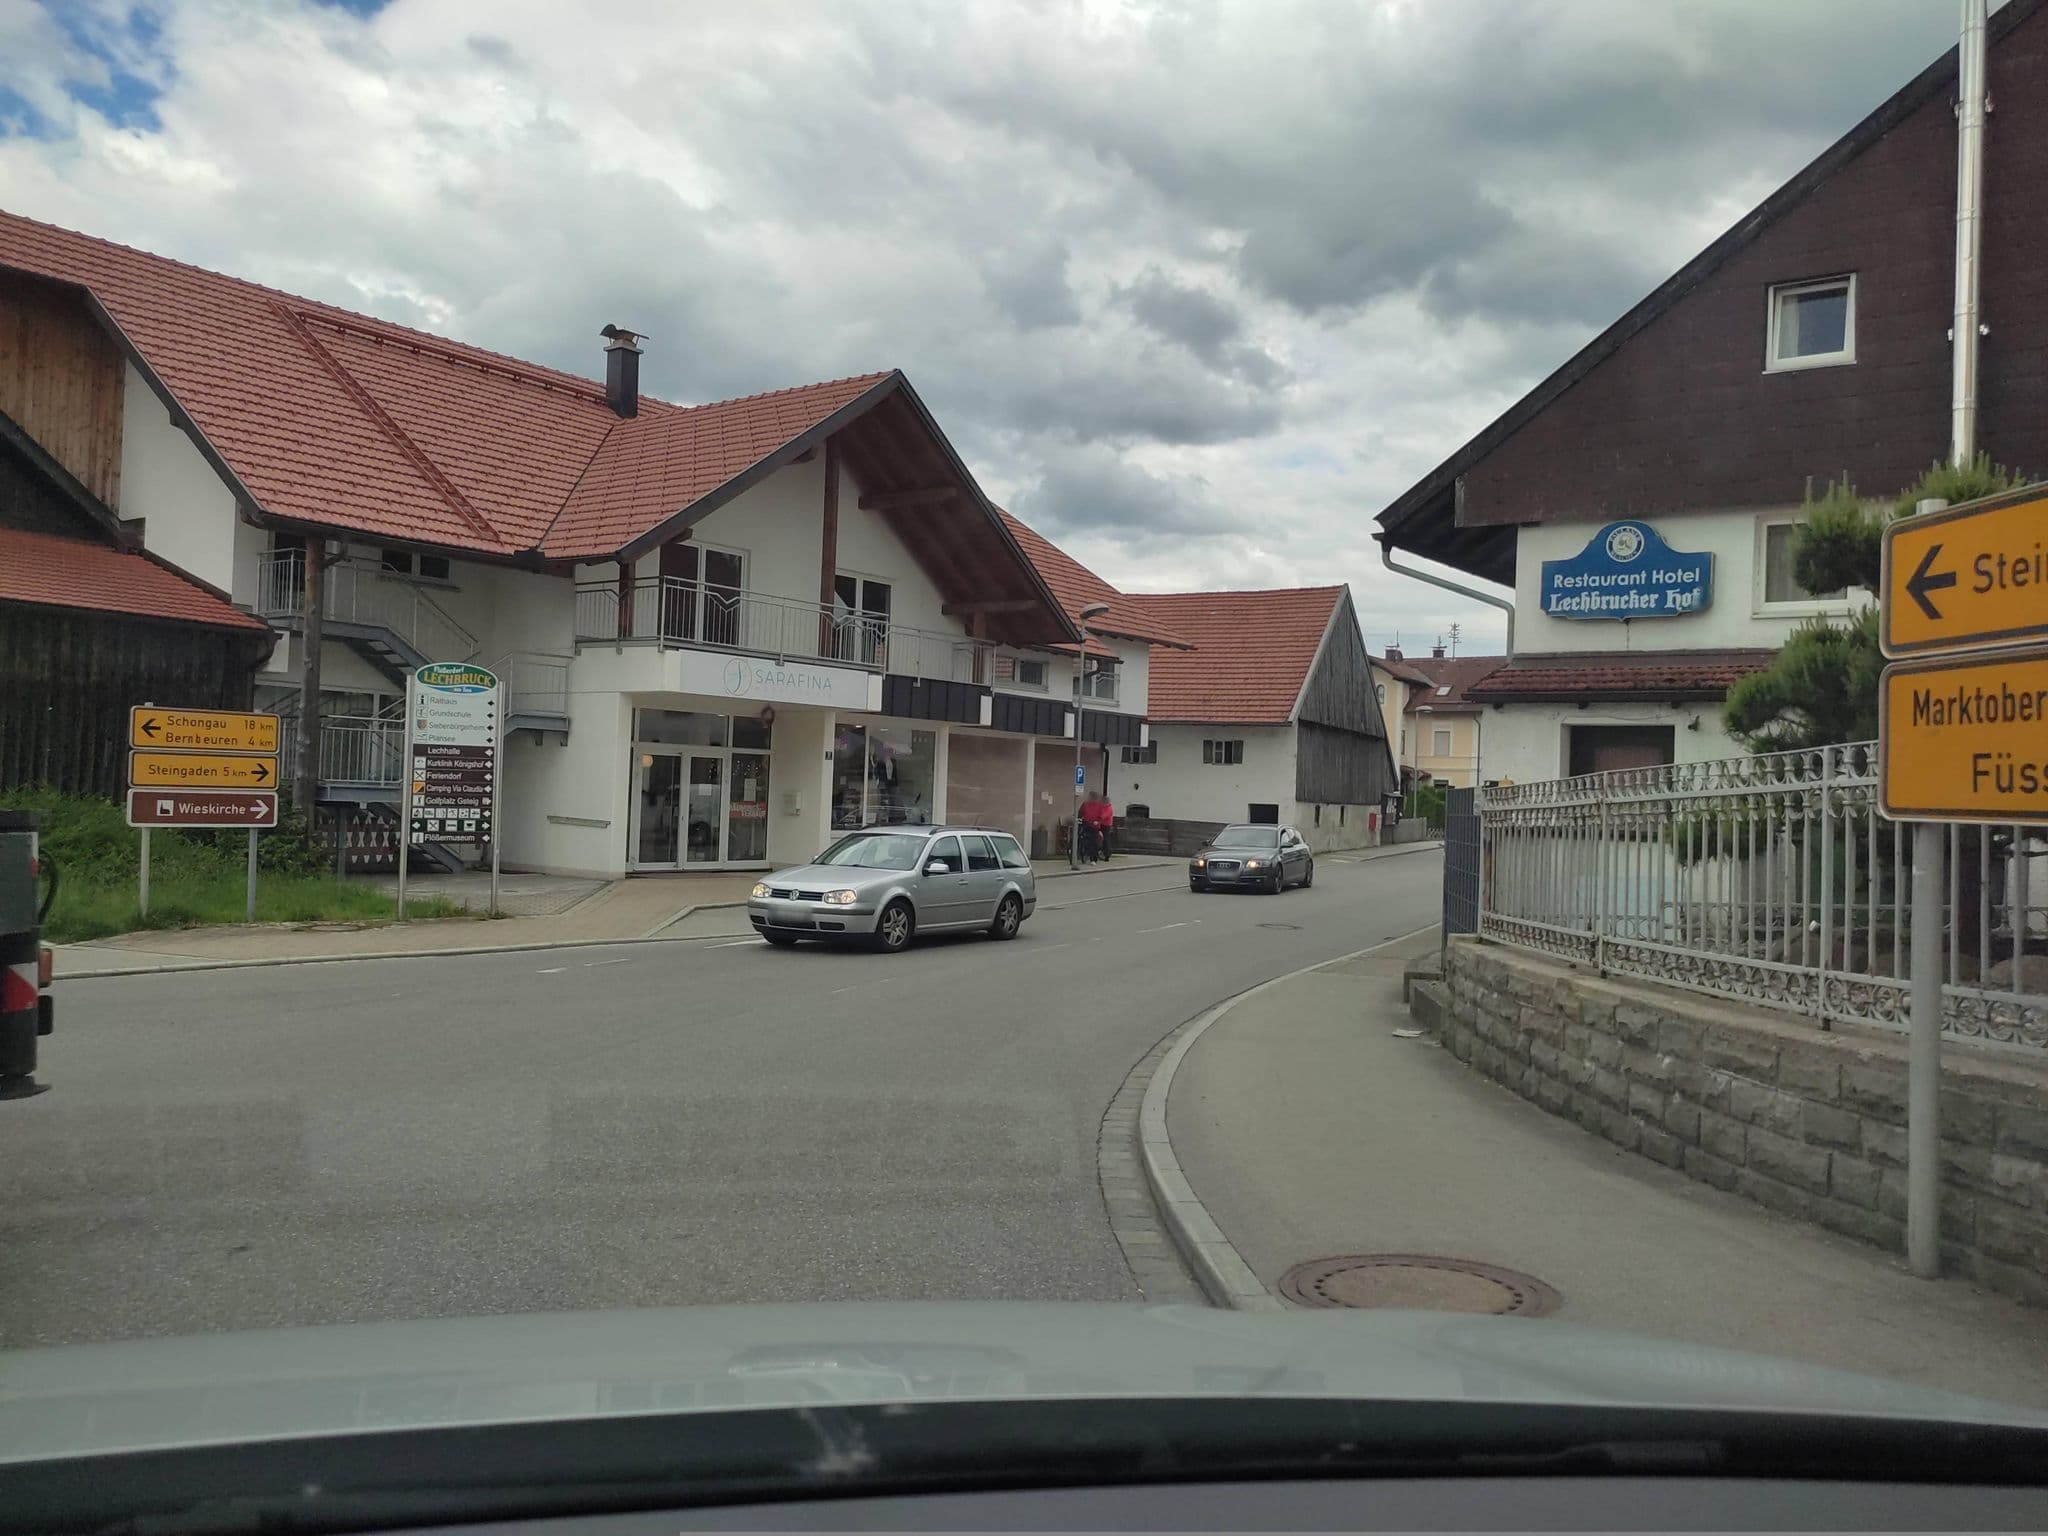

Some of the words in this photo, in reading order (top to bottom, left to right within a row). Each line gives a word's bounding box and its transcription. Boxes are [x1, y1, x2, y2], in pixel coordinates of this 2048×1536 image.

[1972, 542, 2048, 594] Stei
[1553, 570, 1647, 588] Restaurant
[1651, 568, 1700, 585] Hotel
[1548, 590, 1659, 612] Lechbrucker
[1664, 588, 1703, 611] Hof
[423, 671, 492, 687] LECHBRUCK
[755, 669, 833, 690] SARAFINA
[429, 696, 458, 705] Rathaus
[429, 709, 472, 718] Grundschule
[167, 715, 227, 731] Schongau
[244, 719, 256, 731] 18
[260, 722, 274, 731] km
[165, 732, 238, 746] Bernbeuren
[248, 736, 255, 747] 4
[259, 739, 274, 747] km
[427, 747, 461, 755] Lechhalle
[148, 764, 218, 778] Steingaden
[223, 766, 230, 777] 5
[232, 768, 247, 777] km
[454, 760, 484, 769] Königshof
[426, 771, 463, 780] Feriendorf
[1077, 767, 1083, 782] P
[426, 784, 452, 793] Camping
[462, 785, 484, 793] Claudia
[425, 796, 456, 806] Golfplatz
[178, 802, 246, 815] Wieskirche
[424, 833, 475, 842] Flößermuseum
